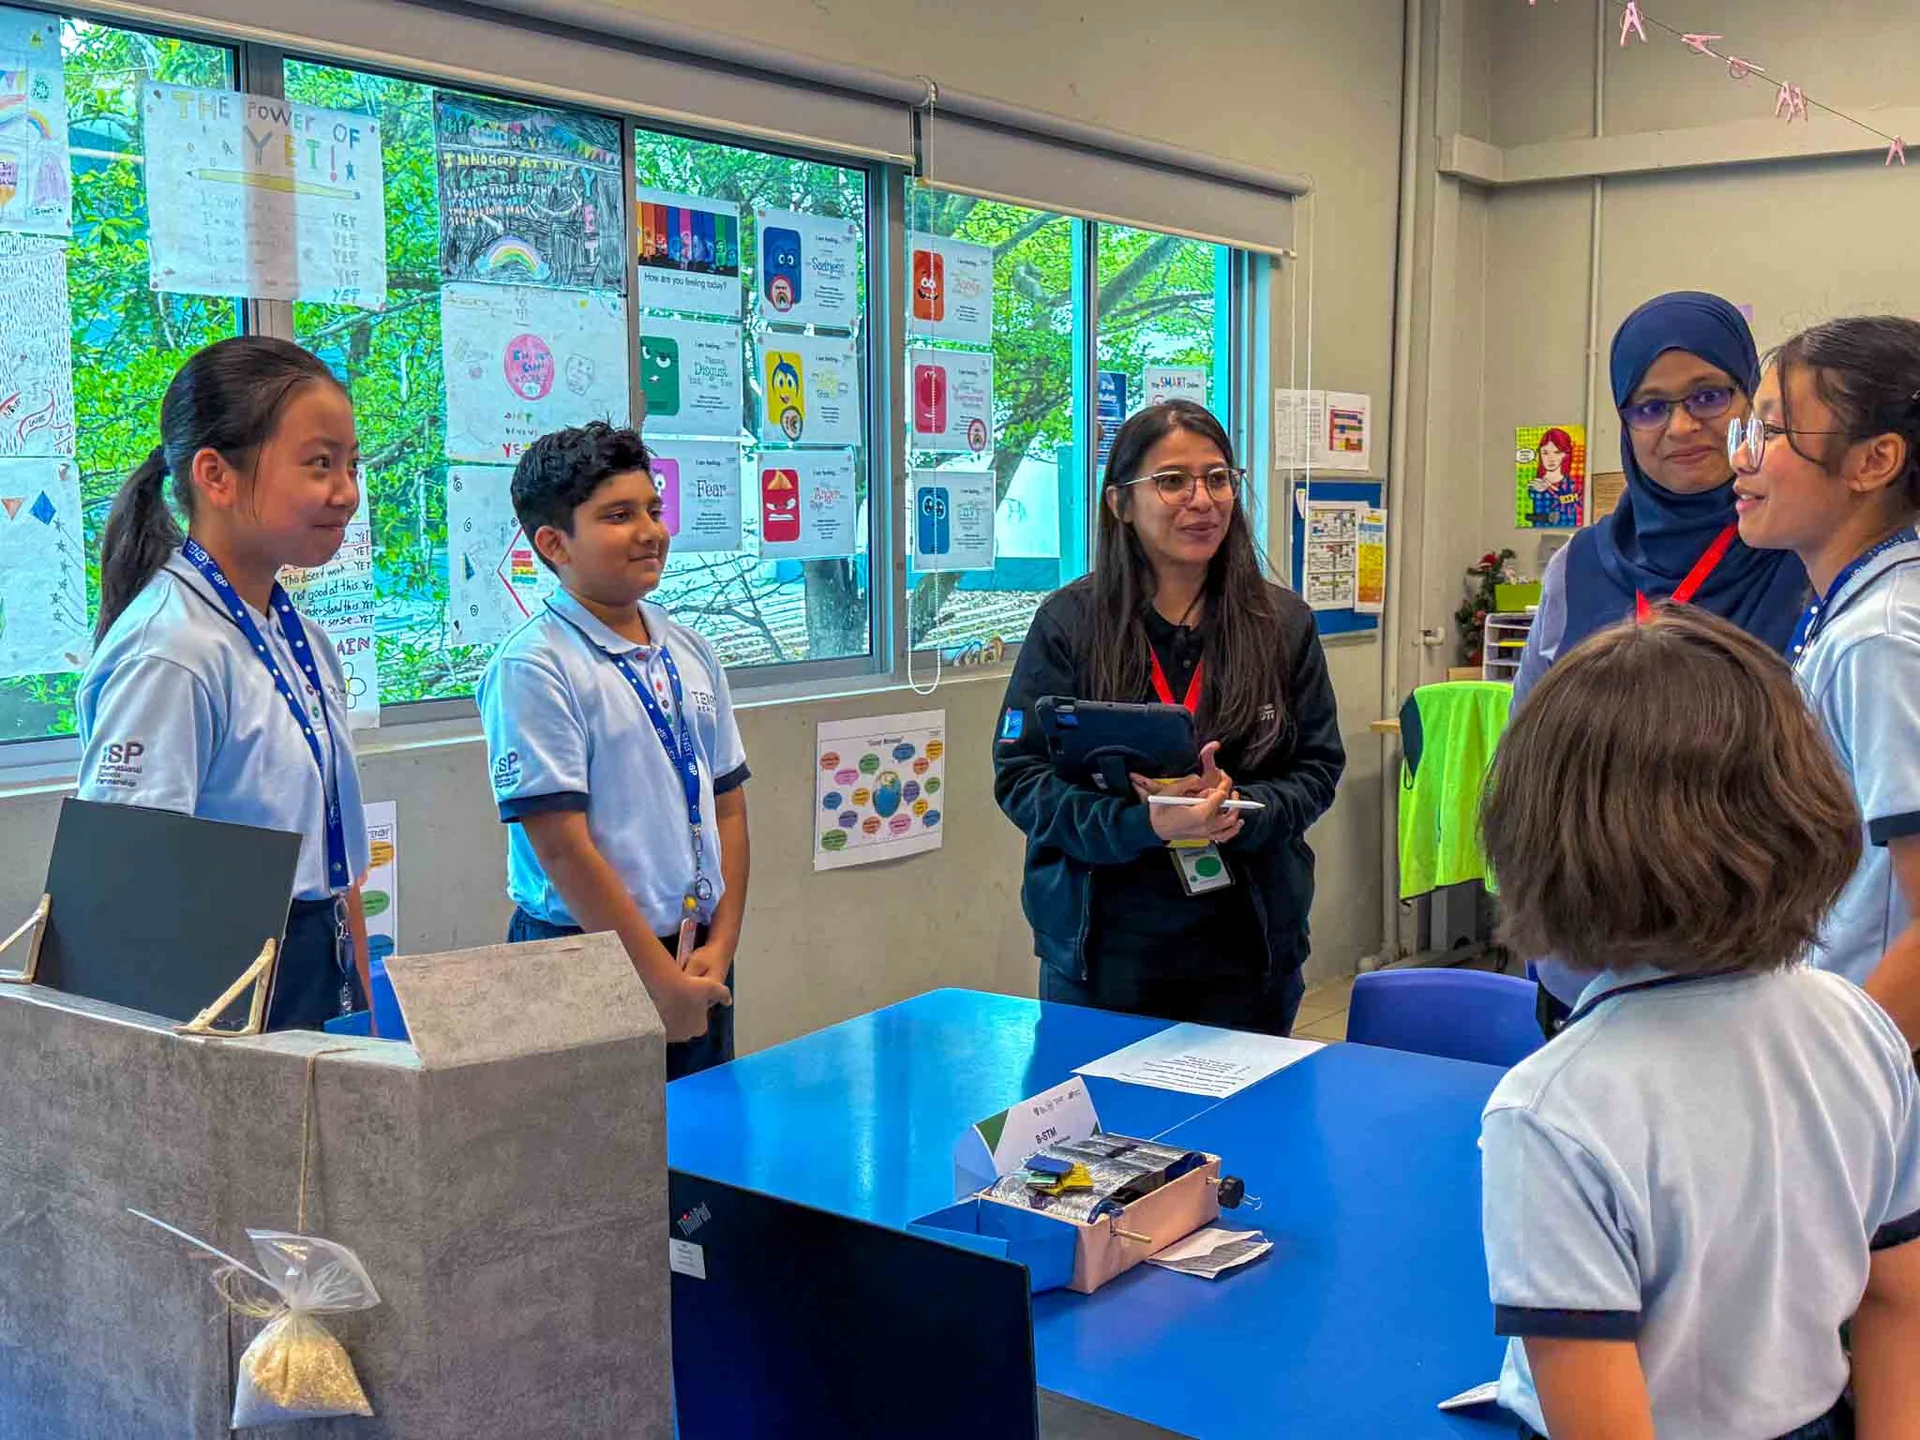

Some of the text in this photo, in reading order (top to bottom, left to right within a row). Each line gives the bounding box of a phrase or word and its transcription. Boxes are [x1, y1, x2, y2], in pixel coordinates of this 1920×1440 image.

[332, 123, 361, 150] OF
[644, 272, 659, 283] How
[661, 275, 671, 284] are
[672, 275, 684, 286] you
[685, 276, 706, 289] feeling
[697, 479, 726, 497] Fear
[354, 546, 369, 556] YET
[354, 560, 371, 571] YET
[308, 581, 327, 602] good
